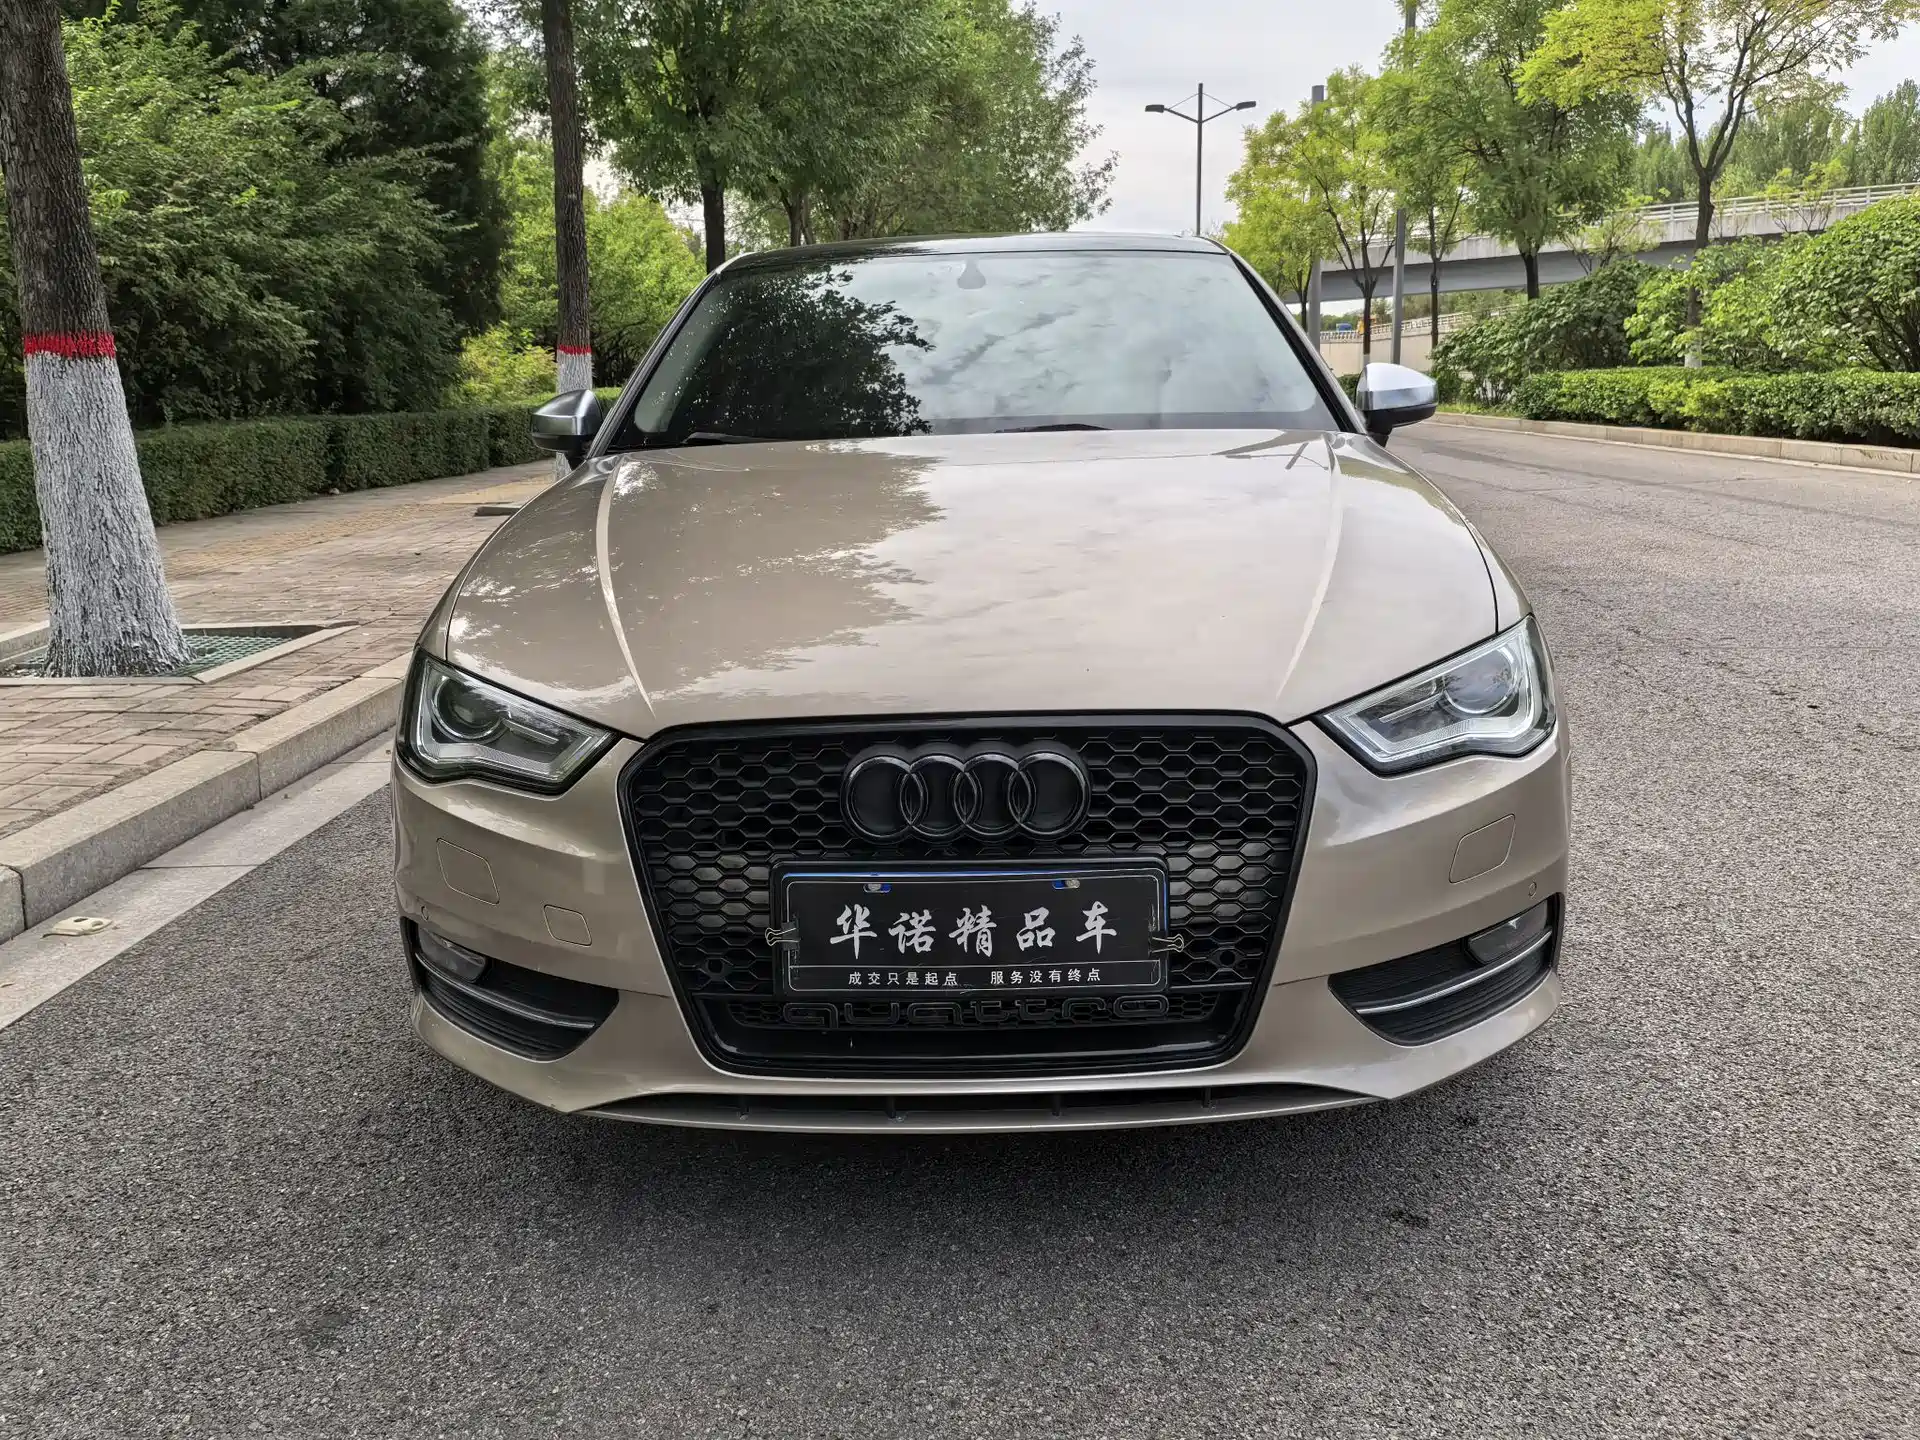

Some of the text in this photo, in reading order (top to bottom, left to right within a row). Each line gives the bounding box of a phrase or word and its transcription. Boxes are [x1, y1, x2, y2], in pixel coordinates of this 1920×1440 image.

[829, 900, 1118, 960] 华诺精品车
[847, 967, 1102, 987] 成交只是起点 服务没有终点
[783, 996, 1169, 1029] quattro
